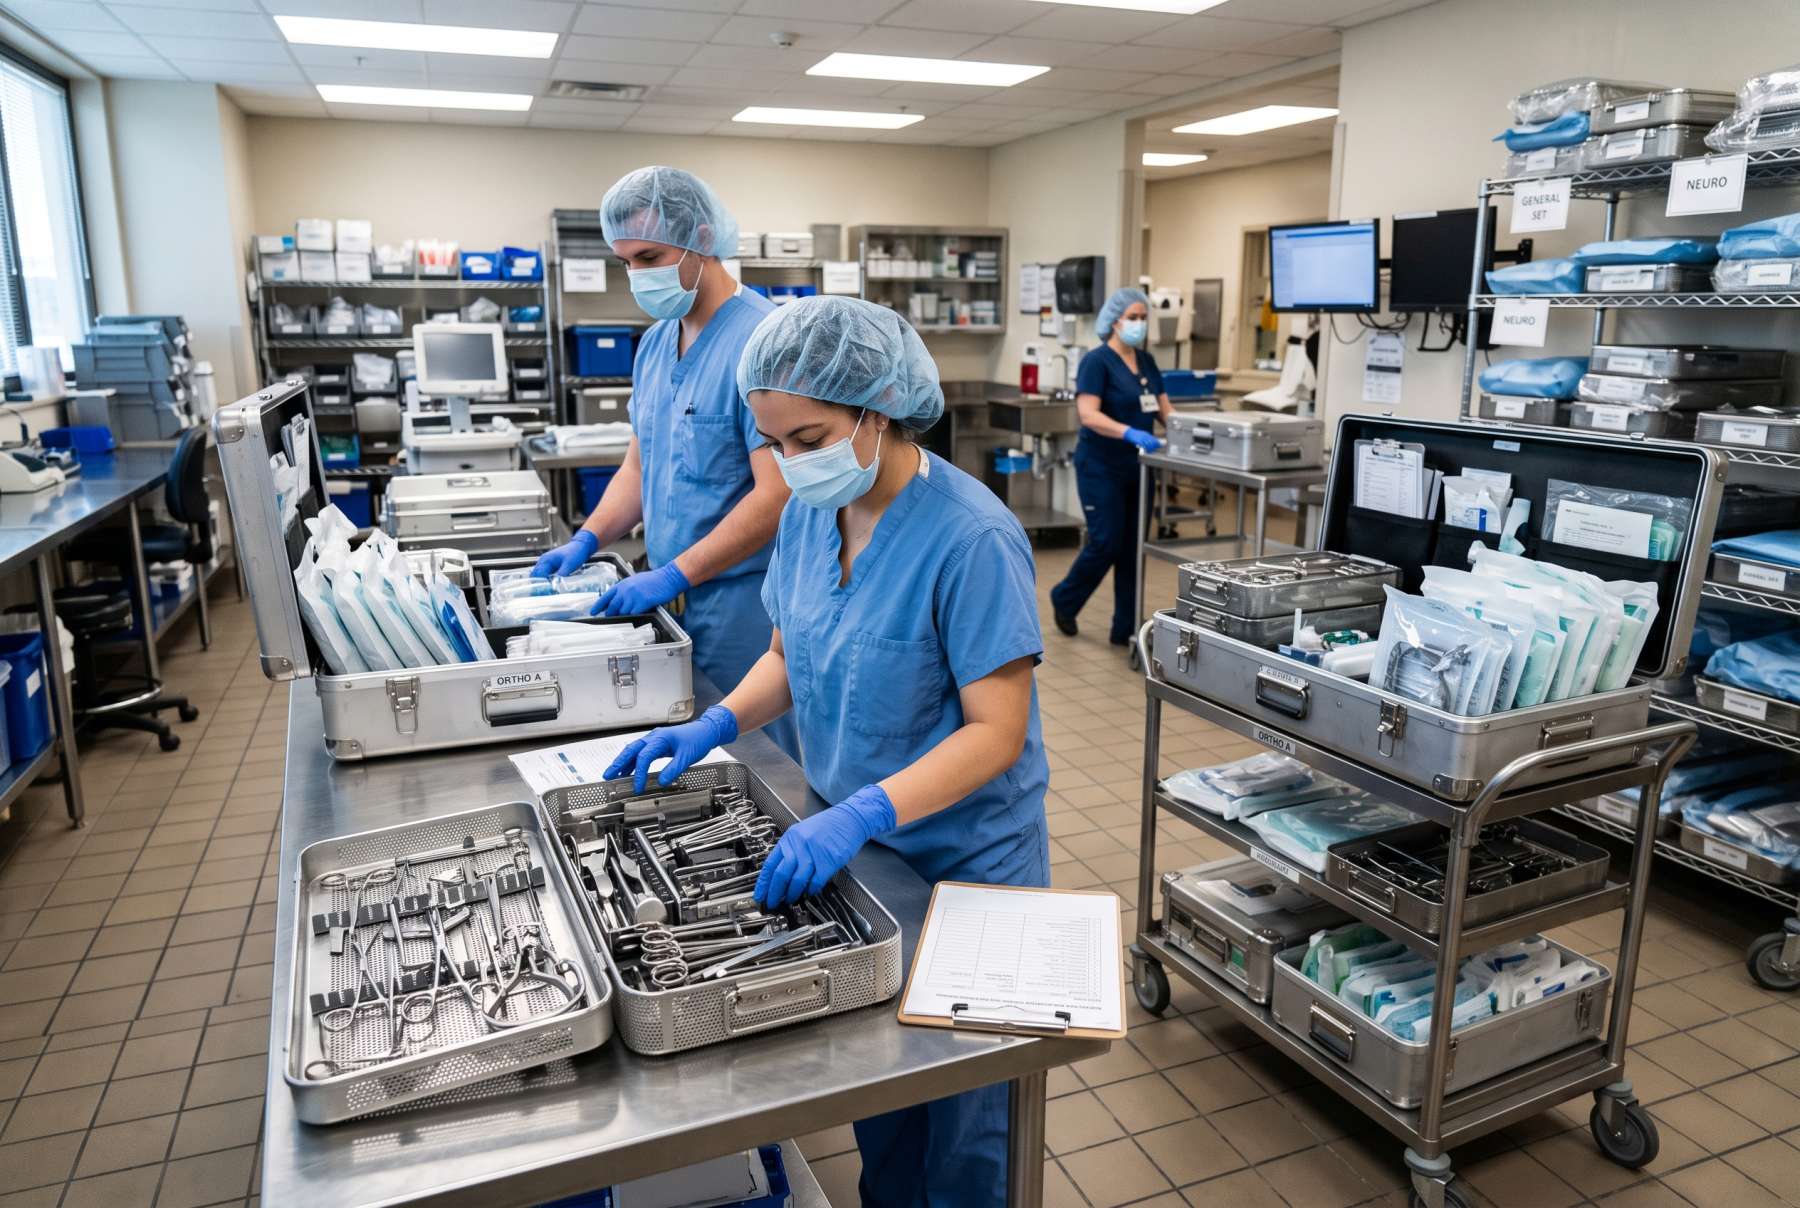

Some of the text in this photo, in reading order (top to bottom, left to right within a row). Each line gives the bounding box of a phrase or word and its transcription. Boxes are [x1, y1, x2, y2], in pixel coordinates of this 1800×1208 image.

[1687, 176, 1728, 190] NEURO
[1521, 193, 1561, 206] GENERAL
[1531, 209, 1548, 220] SET
[1503, 315, 1536, 326] NEURO
[497, 673, 542, 685] ORTHO A
[1258, 731, 1291, 753] ORTHO A
